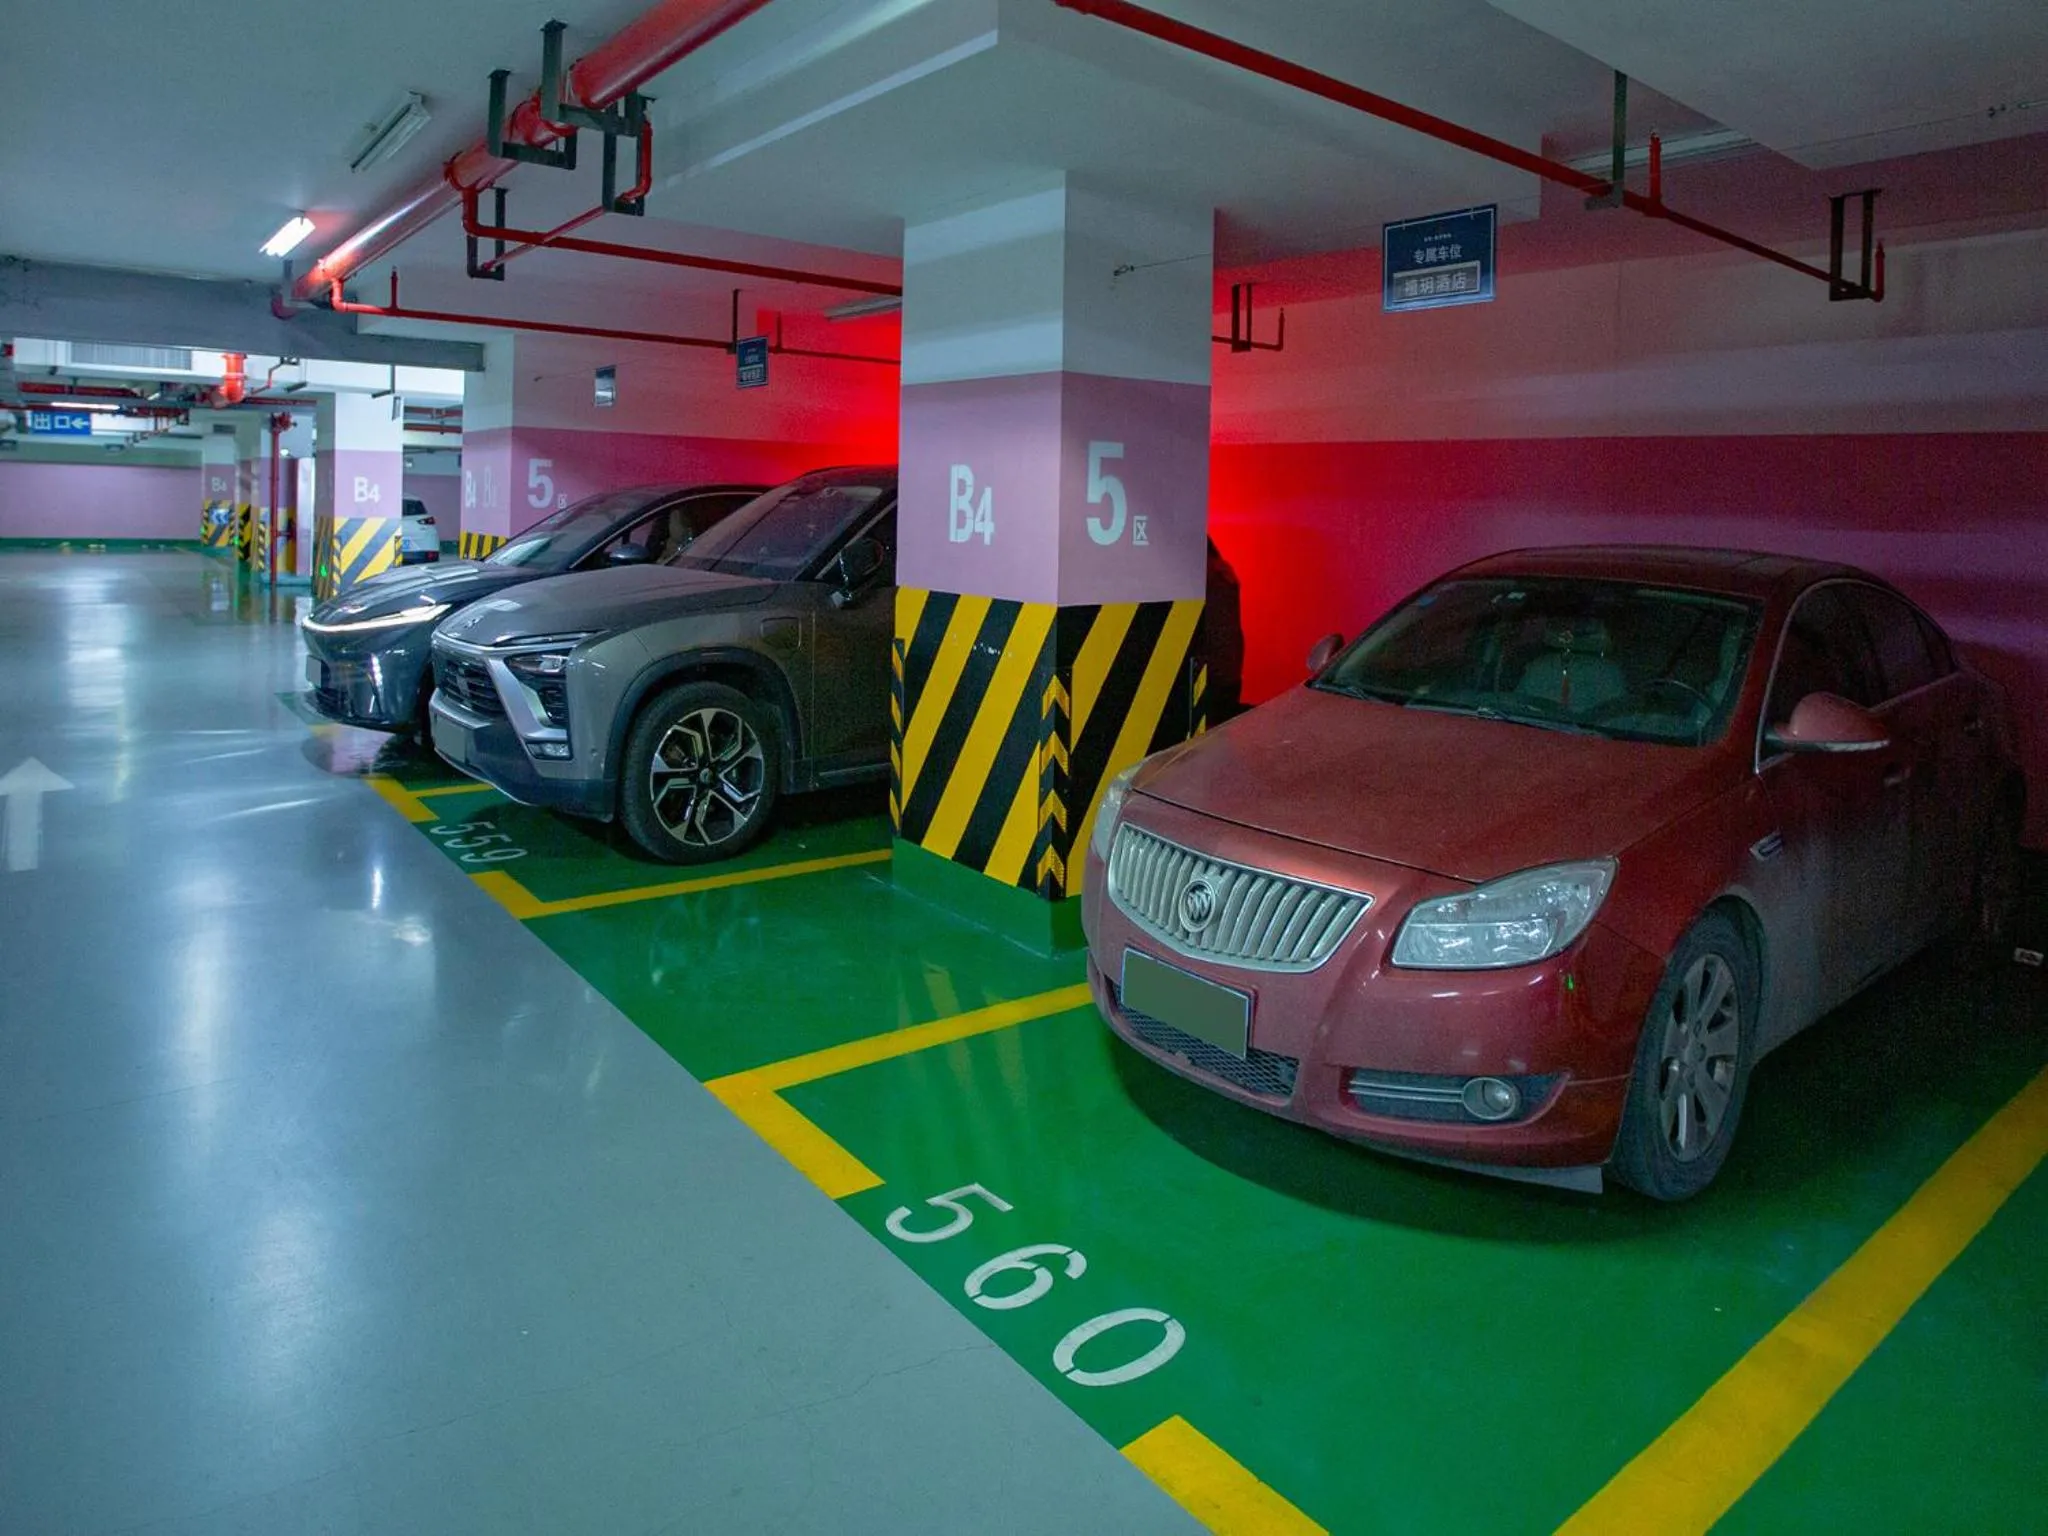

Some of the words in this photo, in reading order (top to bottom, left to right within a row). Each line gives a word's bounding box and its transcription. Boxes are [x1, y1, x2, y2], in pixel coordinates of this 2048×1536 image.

[33, 412, 72, 430] 出口
[354, 476, 381, 503] B4
[949, 464, 995, 546] B4
[429, 821, 528, 862] 559
[885, 1182, 1186, 1387] 560
